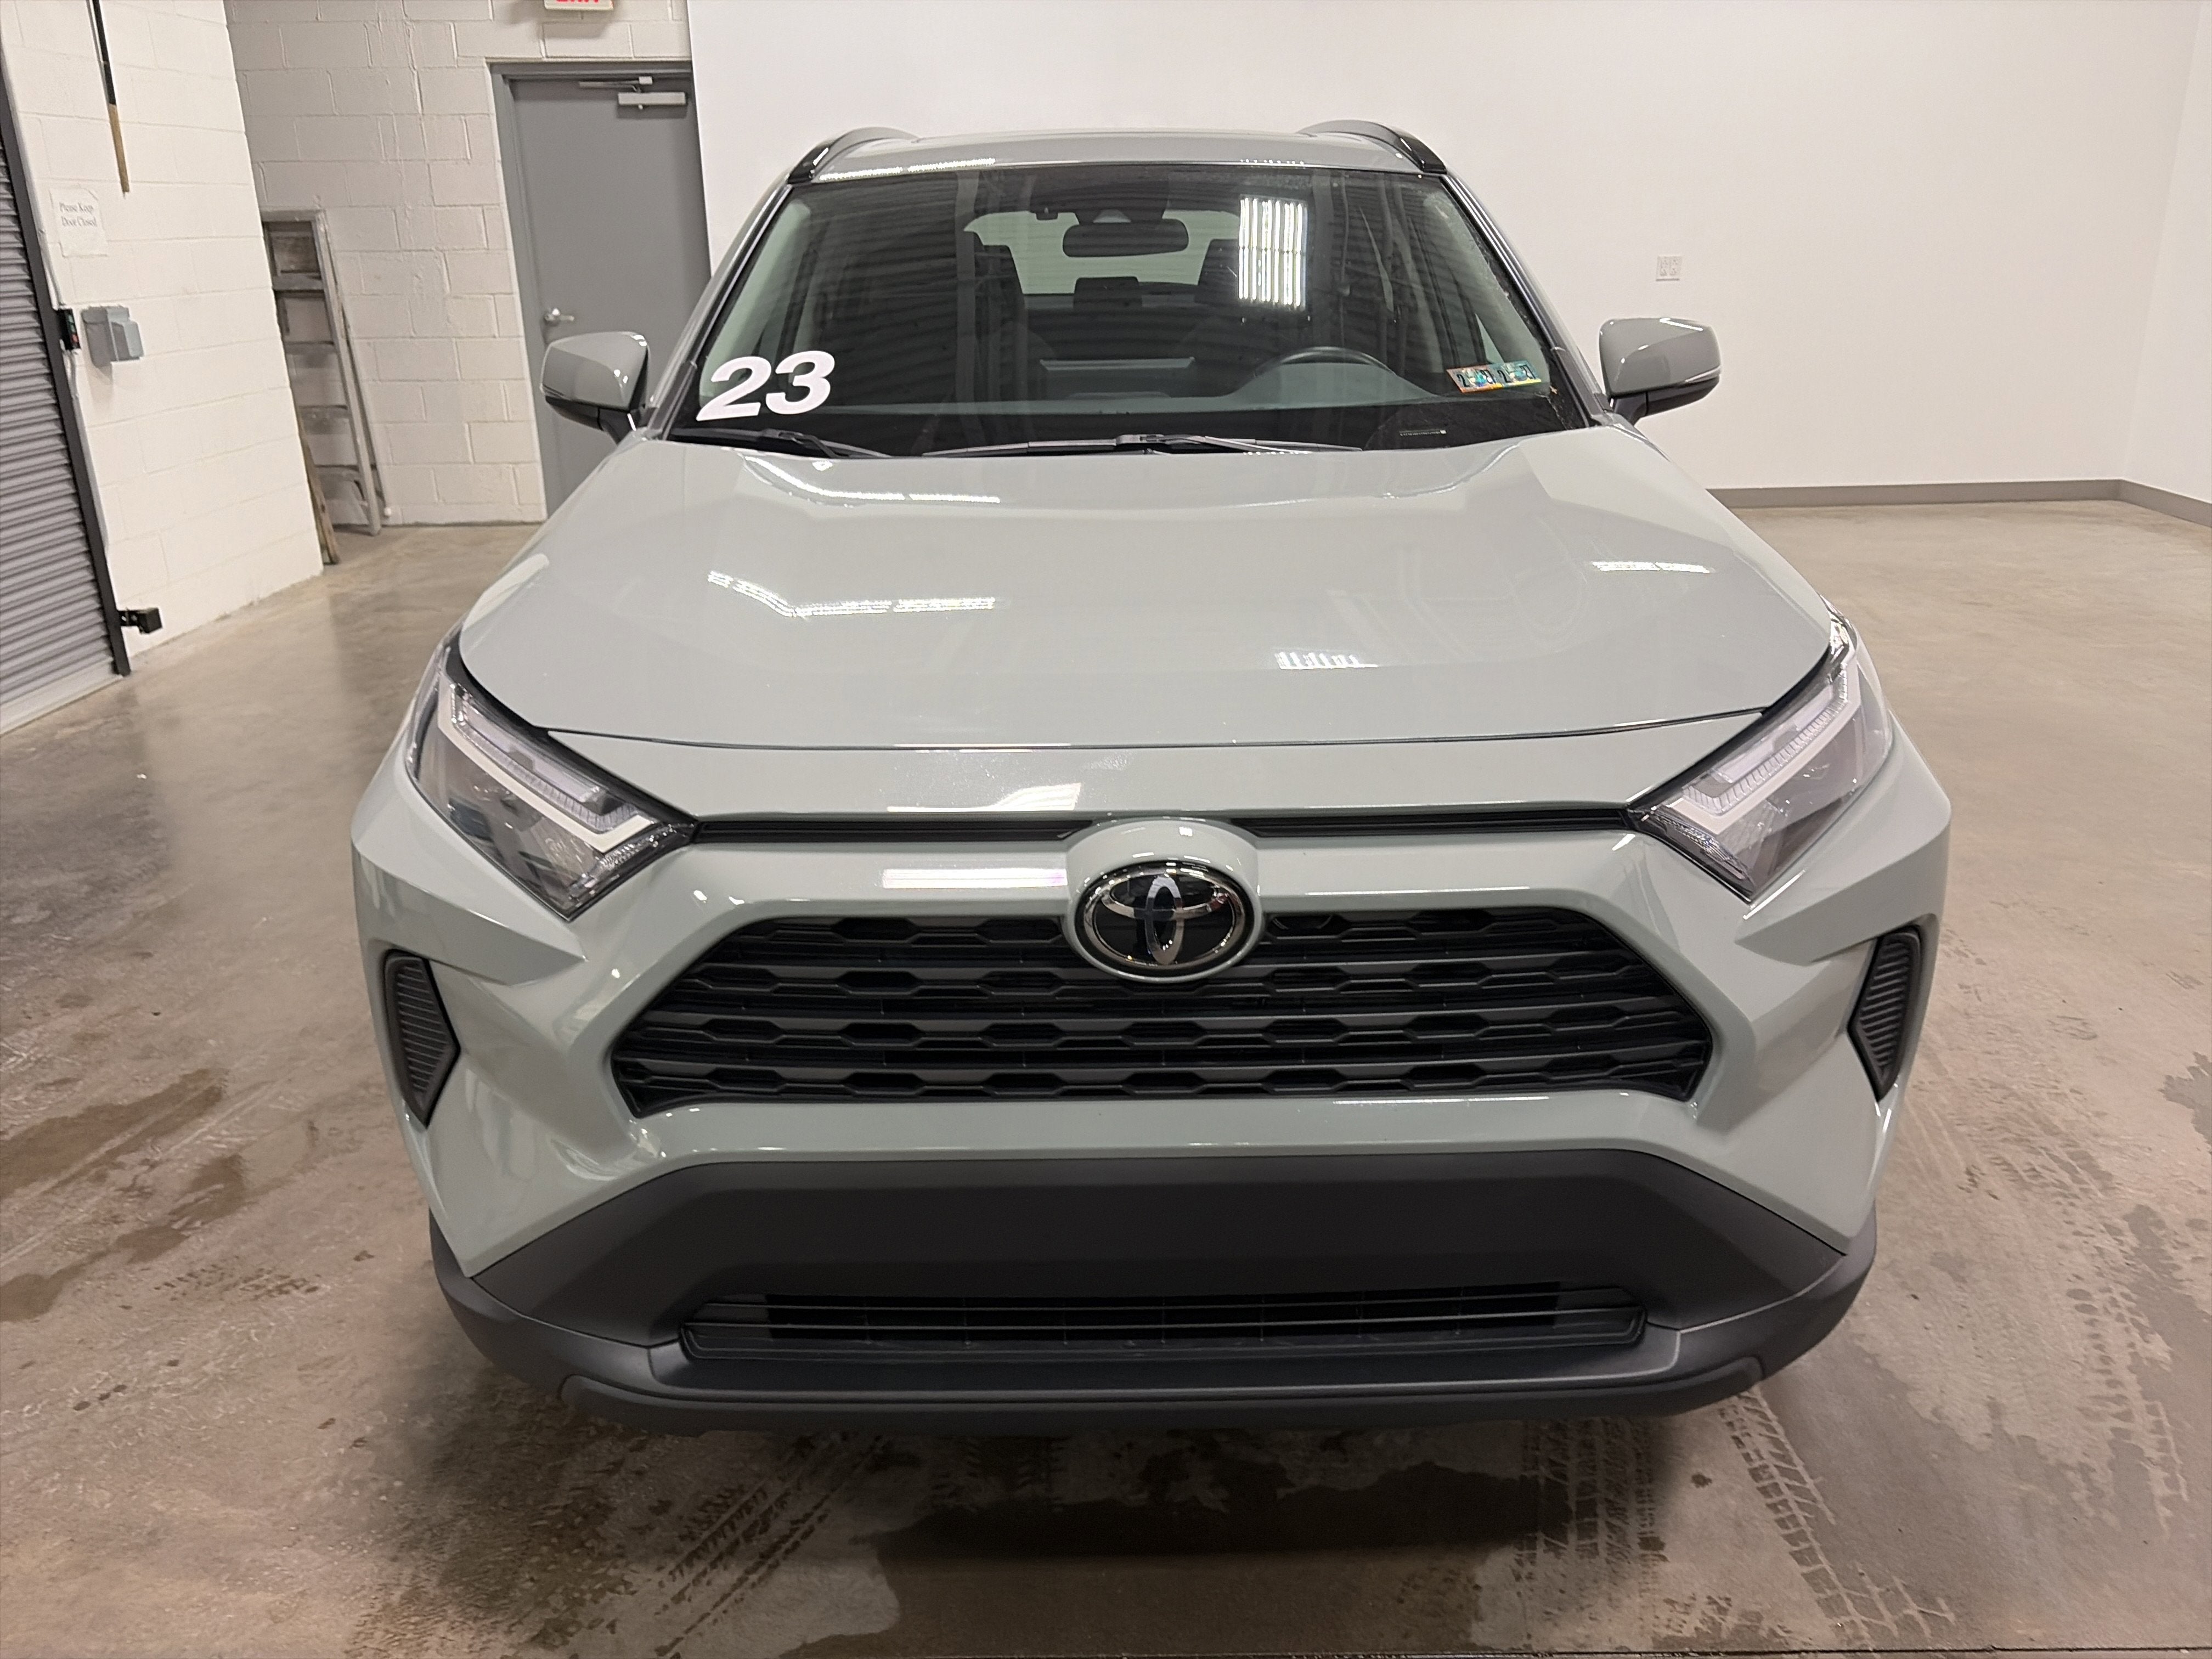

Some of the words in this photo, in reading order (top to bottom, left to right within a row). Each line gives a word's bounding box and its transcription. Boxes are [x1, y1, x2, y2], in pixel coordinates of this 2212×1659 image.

[59, 201, 77, 212] Please
[77, 202, 94, 215] Keep
[61, 216, 77, 227] Door
[77, 216, 97, 227] Closed
[1457, 374, 1470, 387] 2
[1497, 370, 1513, 383] 2
[696, 351, 835, 421] 23
